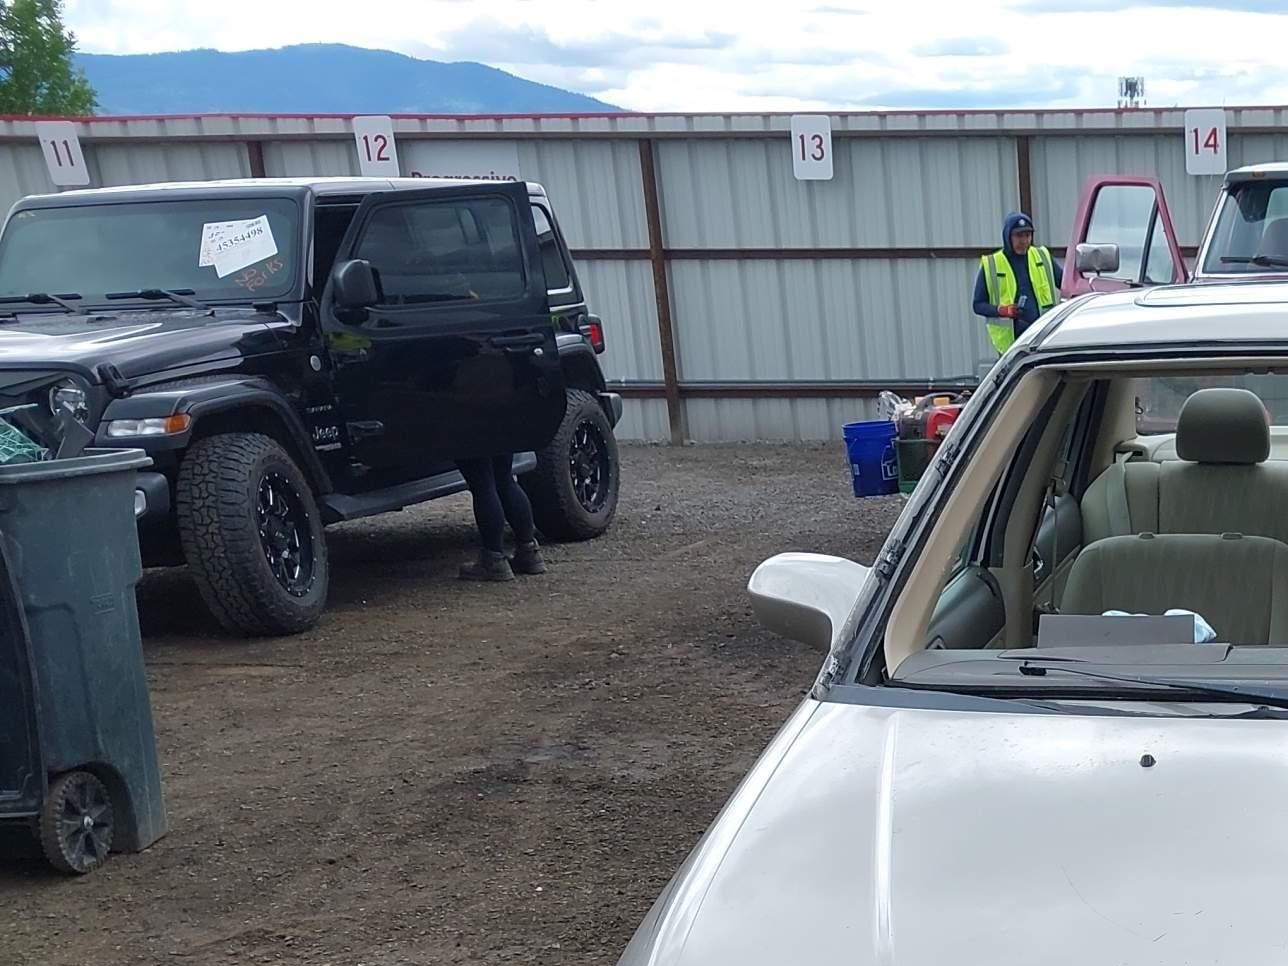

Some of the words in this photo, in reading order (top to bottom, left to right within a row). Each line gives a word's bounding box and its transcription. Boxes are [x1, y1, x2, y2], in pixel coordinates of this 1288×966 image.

[50, 139, 75, 167] 11
[362, 134, 390, 162] 12
[799, 134, 825, 161] 13
[1193, 127, 1220, 155] 14
